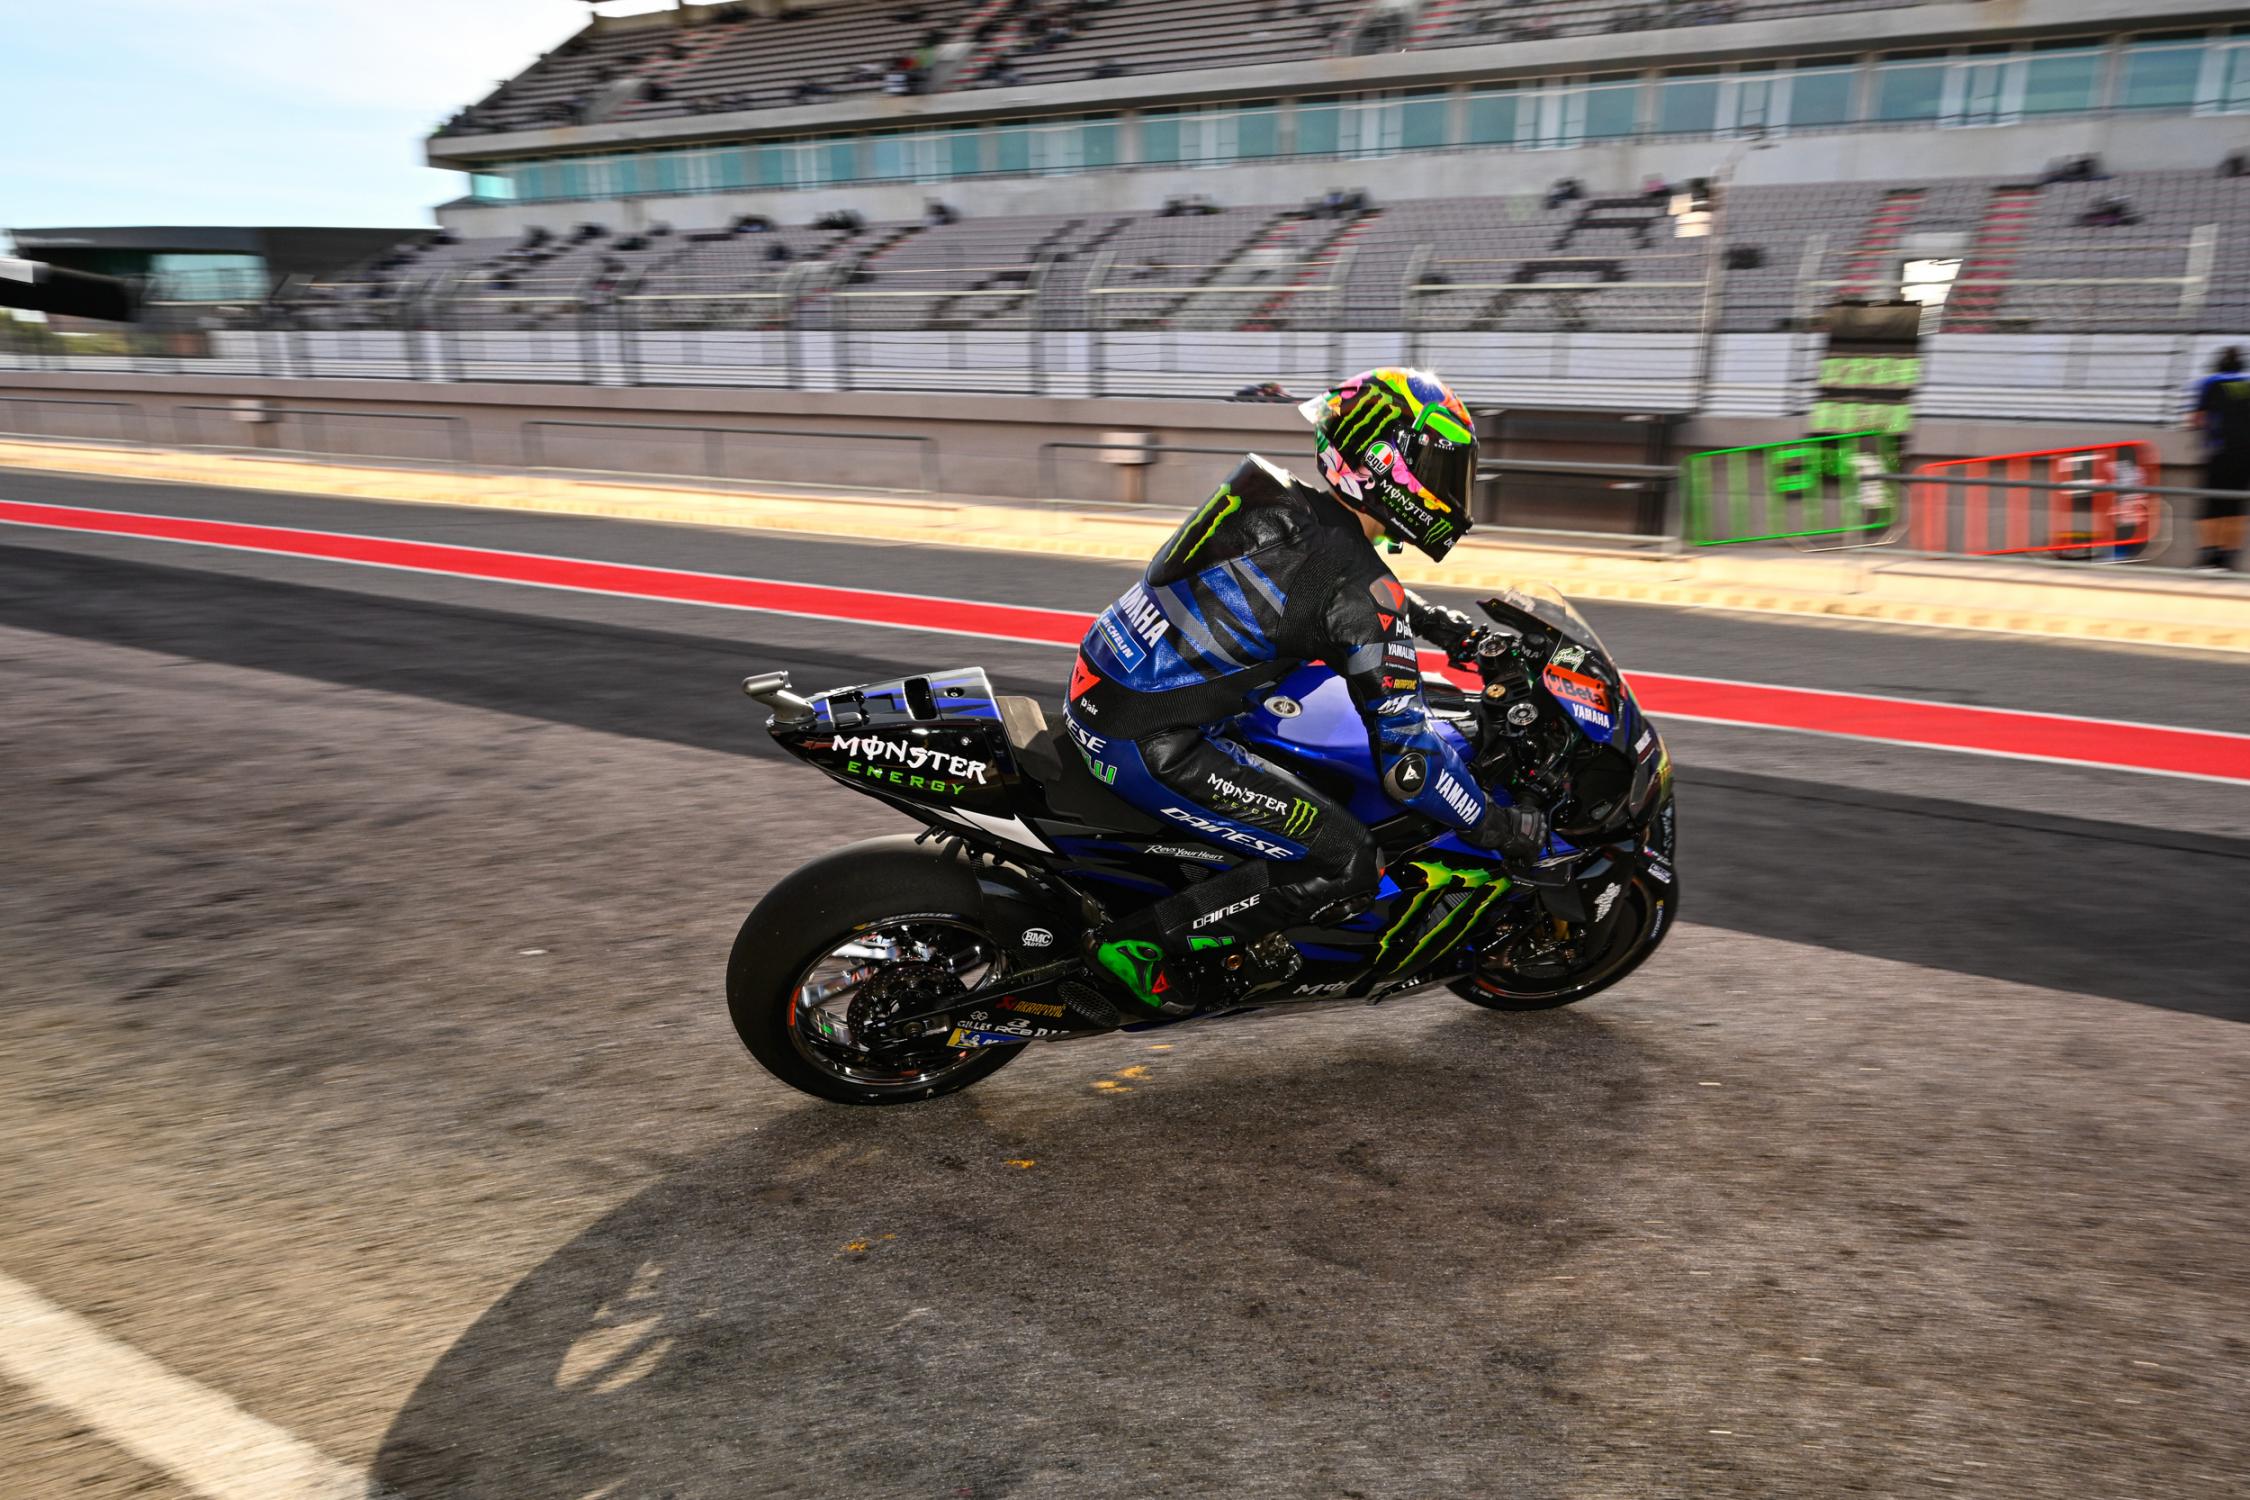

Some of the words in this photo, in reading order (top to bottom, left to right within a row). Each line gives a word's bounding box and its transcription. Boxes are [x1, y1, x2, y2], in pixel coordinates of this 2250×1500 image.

[1380, 479, 1433, 526] MONSTER
[1572, 703, 1610, 728] YAMAHA
[831, 735, 987, 785] MONSTER
[847, 761, 966, 796] ENERGY
[1207, 773, 1288, 816] MONSTER
[1434, 768, 1482, 825] YAMAHA
[1160, 807, 1294, 859] DAINESE
[1193, 894, 1260, 929] DAINESE
[1025, 931, 1051, 945] BMC
[957, 1020, 992, 1031] GILLES
